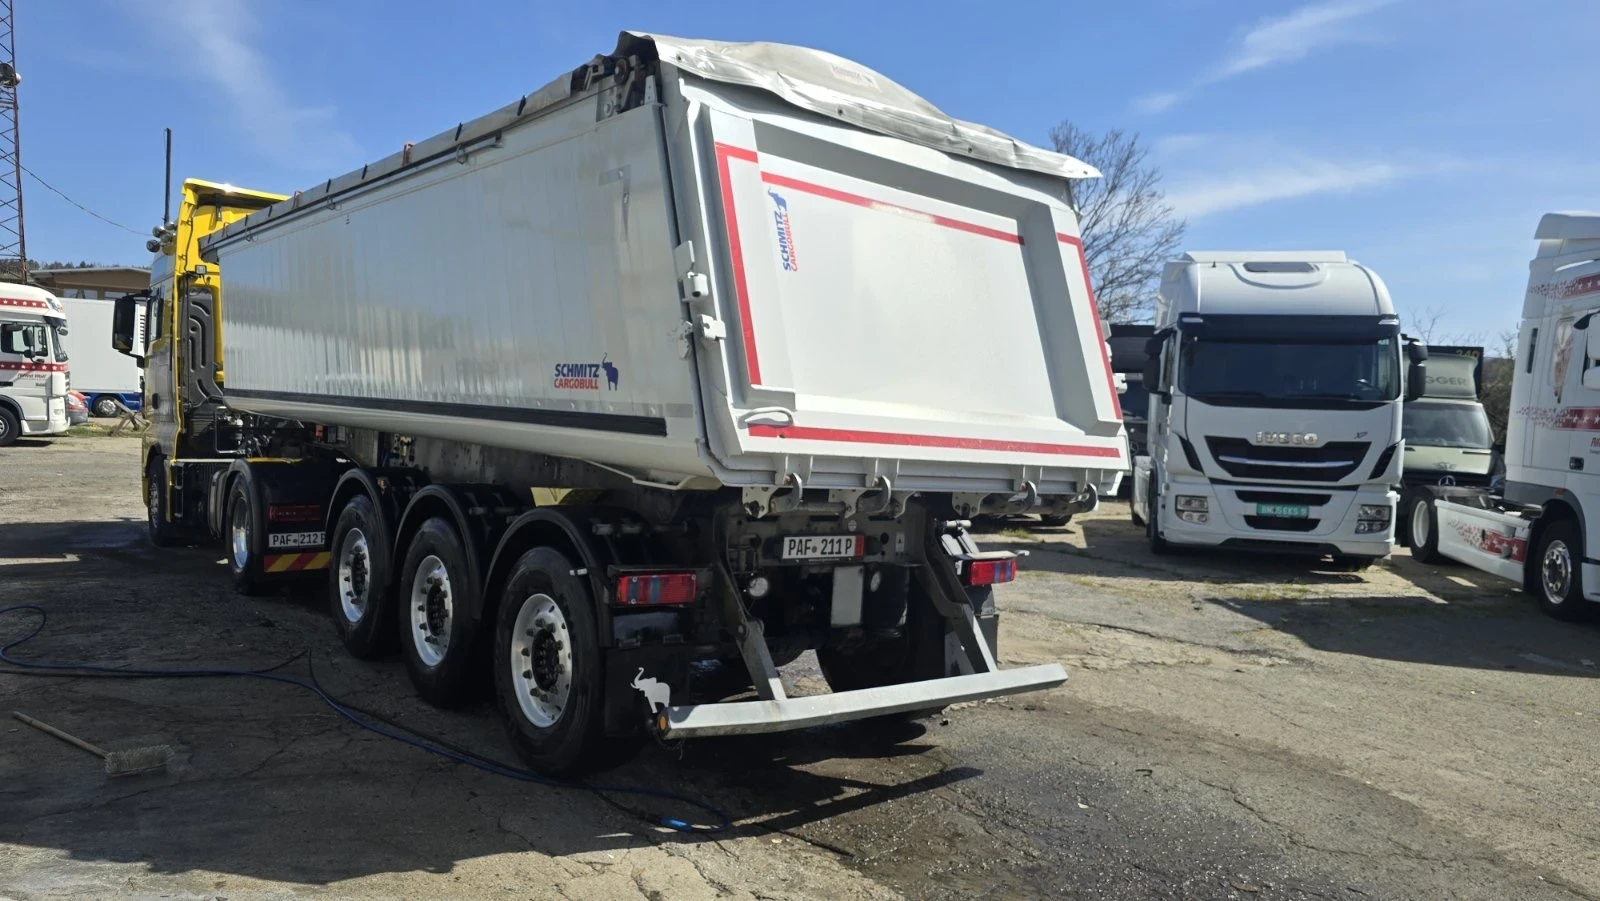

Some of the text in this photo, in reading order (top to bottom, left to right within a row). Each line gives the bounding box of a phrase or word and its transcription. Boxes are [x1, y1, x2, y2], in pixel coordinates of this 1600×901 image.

[774, 210, 792, 272] SCHMITZ
[782, 213, 798, 272] CARGOBULL
[554, 363, 600, 378] SCHMITZ
[554, 378, 599, 390] CARGOBULL
[1256, 431, 1318, 445] IVECO
[272, 534, 293, 546] PAF
[299, 533, 319, 545] 212
[788, 538, 853, 556] PAF 211 P
